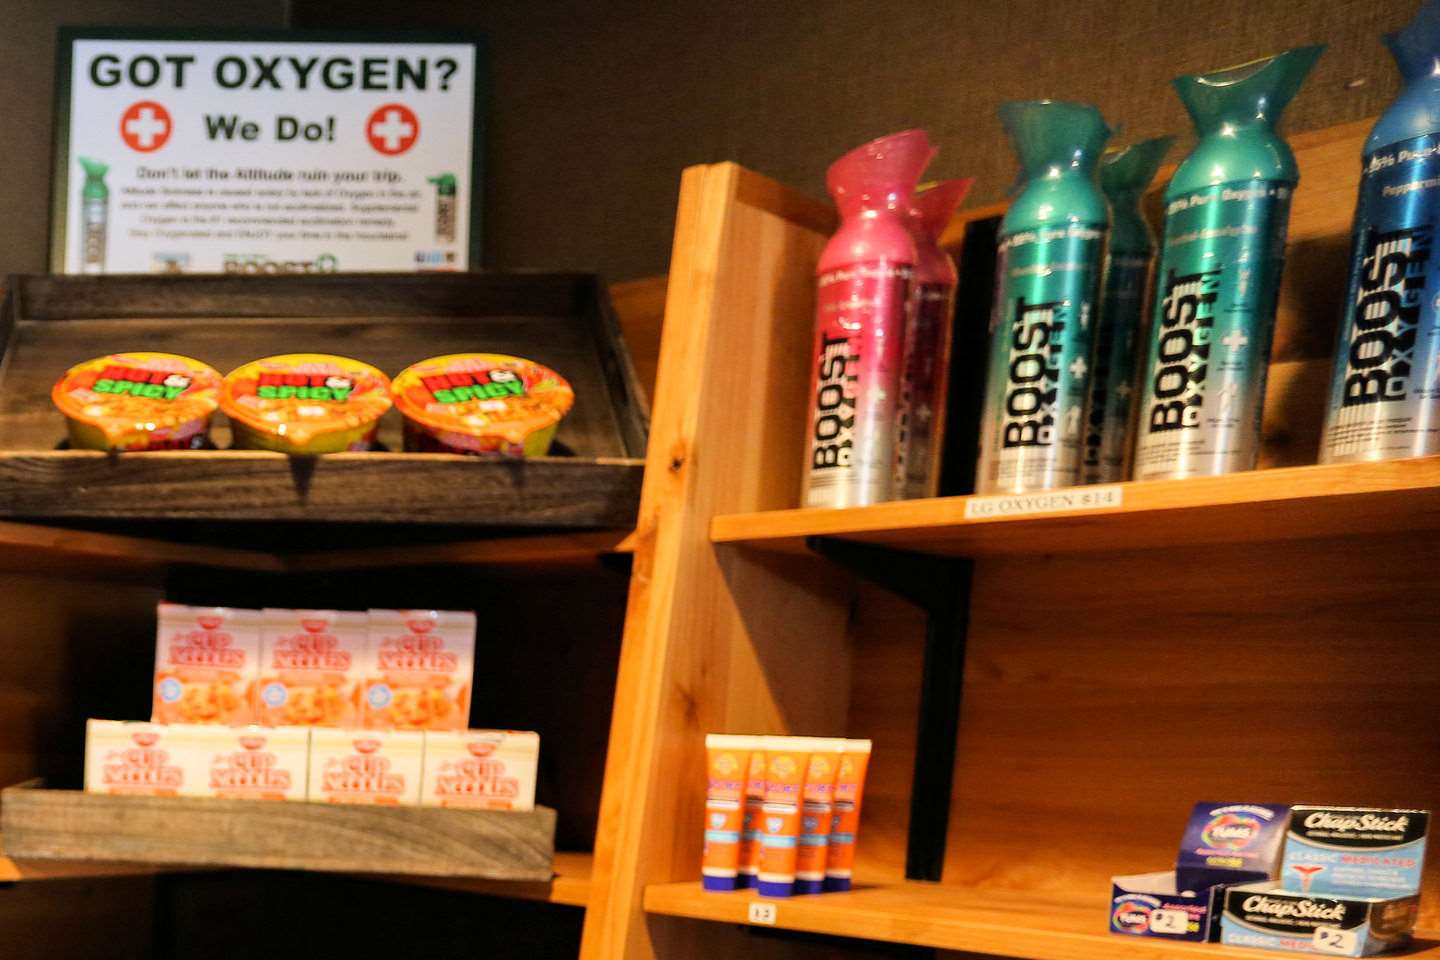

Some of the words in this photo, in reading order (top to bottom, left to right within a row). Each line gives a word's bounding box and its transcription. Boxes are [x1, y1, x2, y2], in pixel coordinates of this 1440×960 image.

[89, 54, 196, 88] GOT
[214, 56, 459, 91] OXYGEN?
[203, 114, 260, 141] We
[274, 116, 337, 142] Do!
[1344, 227, 1412, 407] BOOST
[1384, 225, 1433, 400] OXYGEN
[1149, 267, 1204, 434] BOOST
[1182, 266, 1223, 428] OXYGEN
[99, 365, 170, 384] HOT
[259, 372, 329, 388] HOT
[422, 370, 491, 392] HOT
[1003, 296, 1058, 450] BOOST
[93, 379, 187, 400] SPICY
[257, 385, 351, 400] SPICY
[433, 380, 523, 404] SPICY
[813, 332, 850, 470] BOOST
[998, 494, 1075, 513] OXYGEN
[1303, 811, 1409, 833] ChapStick
[1241, 894, 1347, 921] ChapStick
